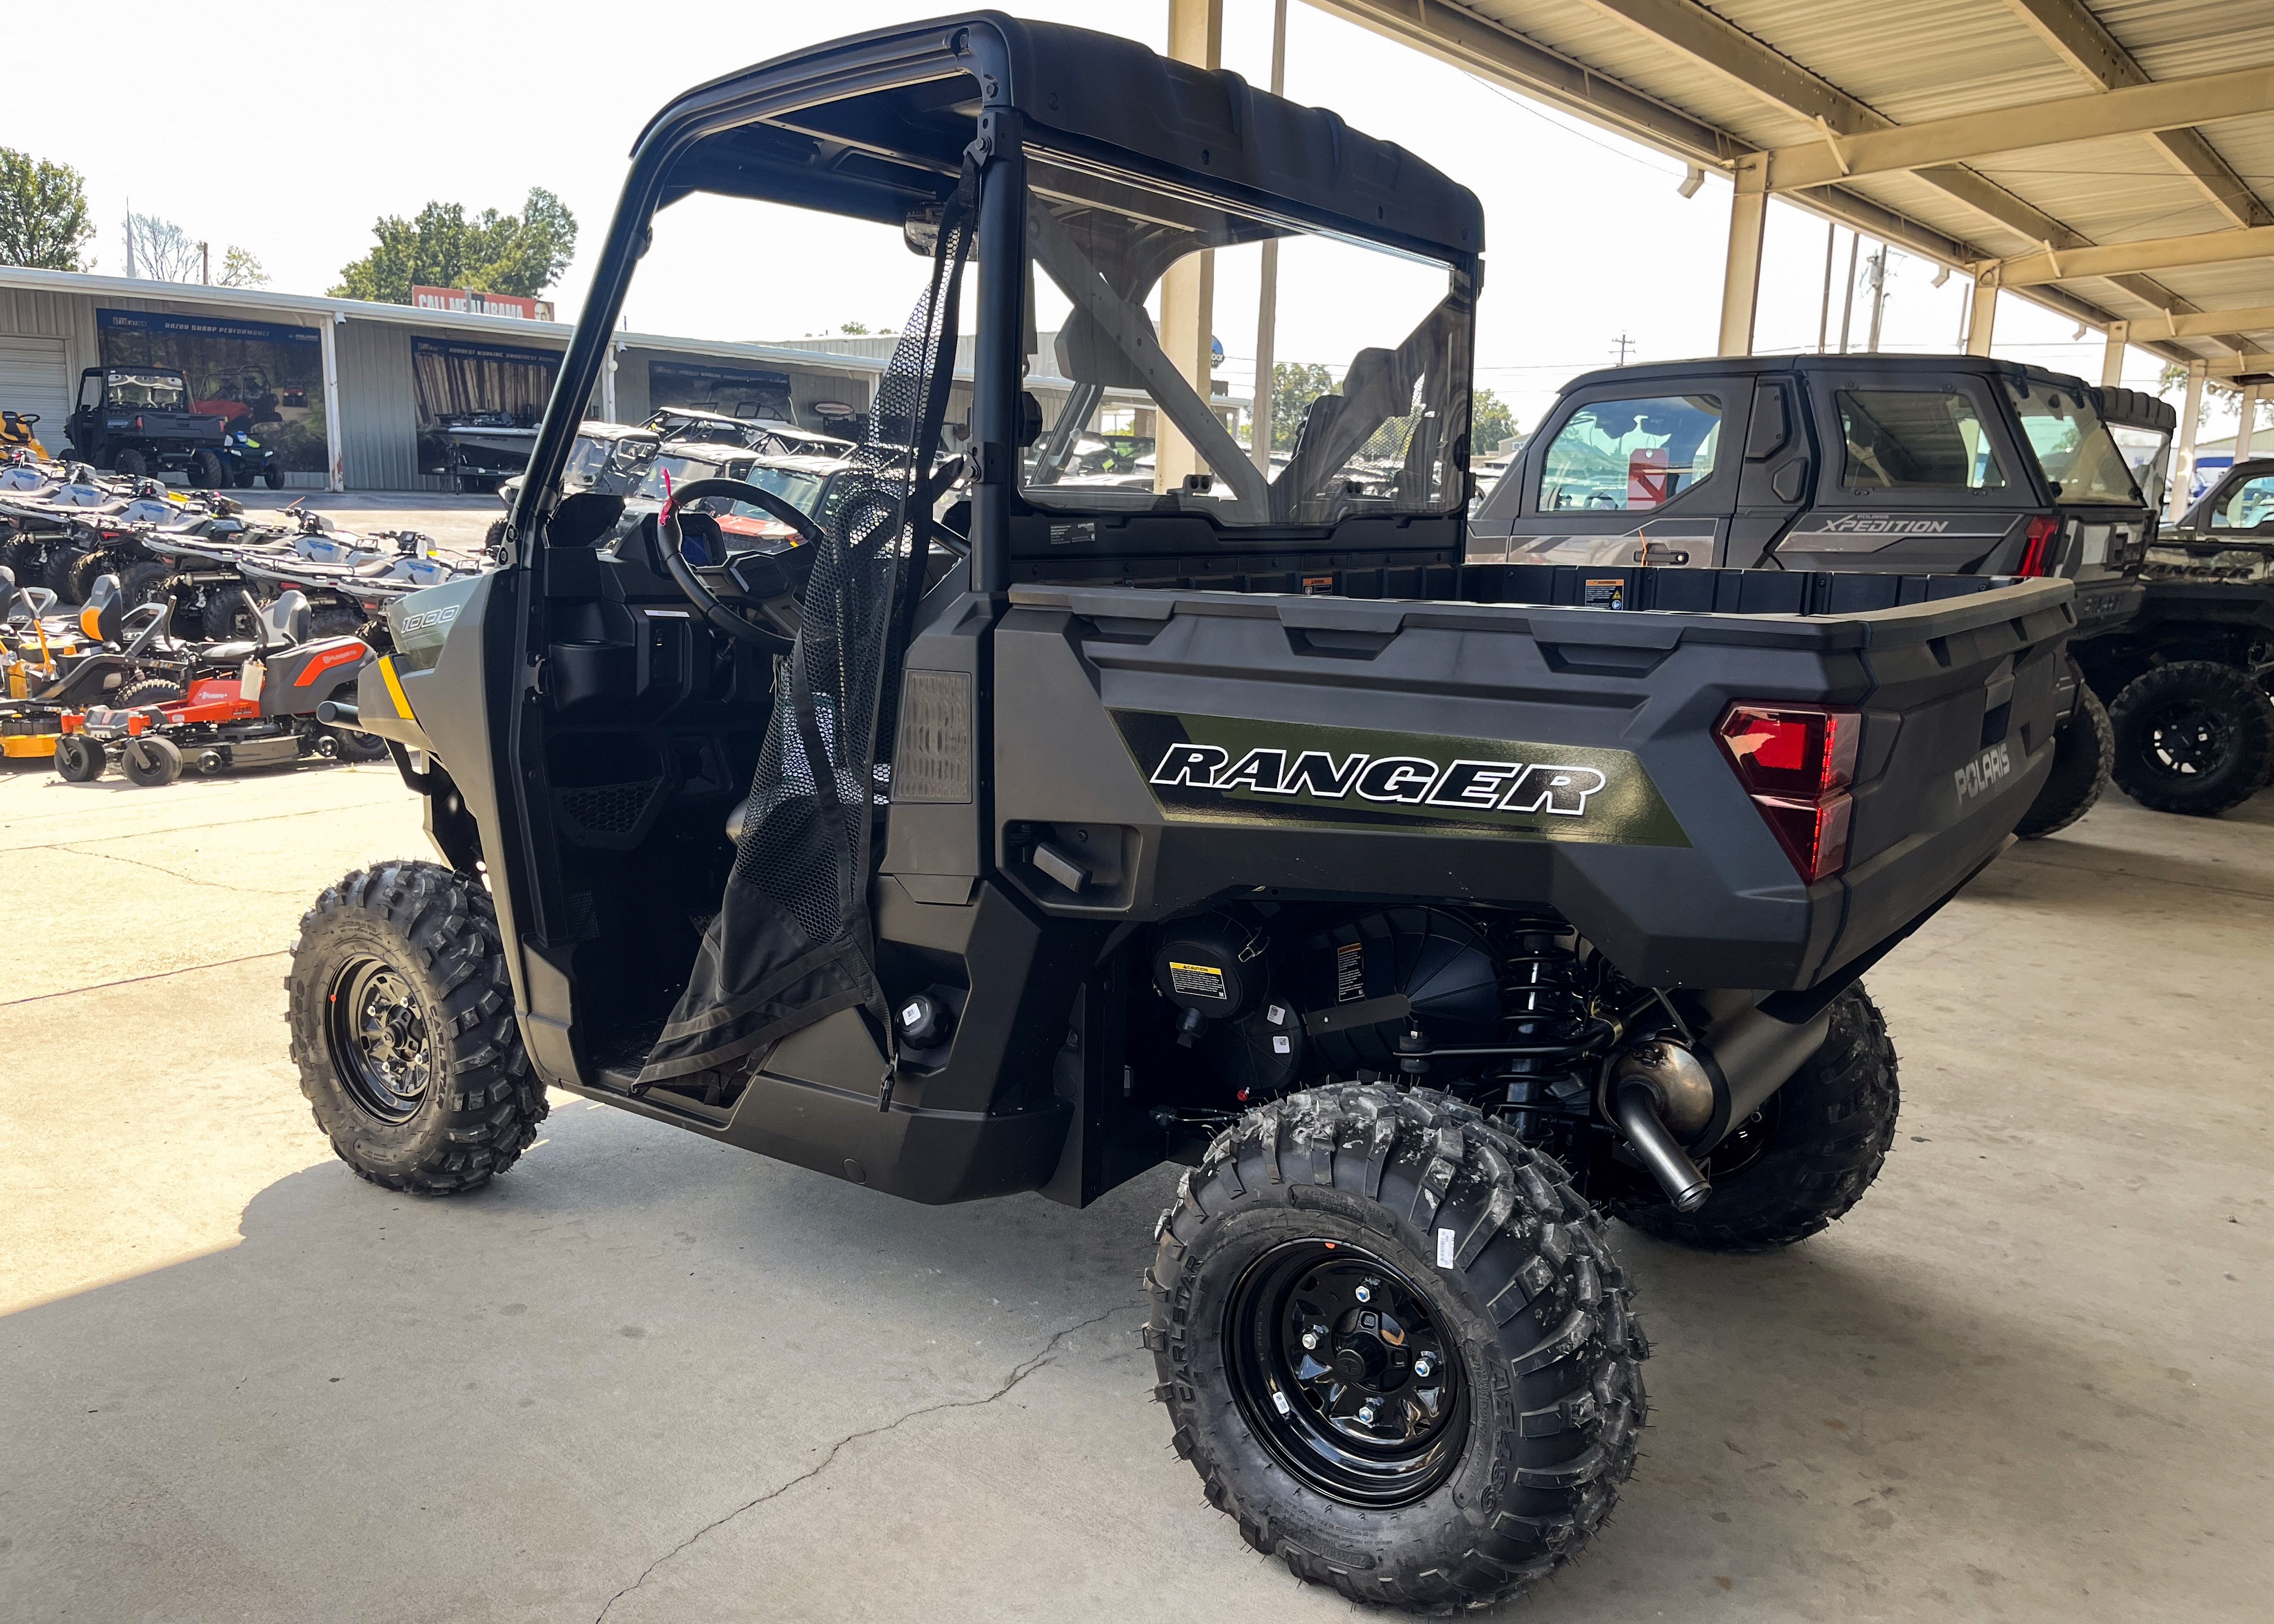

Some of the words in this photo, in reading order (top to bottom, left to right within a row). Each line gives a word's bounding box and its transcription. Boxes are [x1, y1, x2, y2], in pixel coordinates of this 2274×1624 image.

[418, 294, 445, 310] CALL
[218, 327, 271, 337] PERFORMANCE
[1815, 514, 1950, 533] XPEDITION
[401, 604, 460, 634] 1000
[1149, 742, 1607, 817] RANGER
[1954, 742, 2010, 806] POLARIS
[430, 1005, 447, 1110] CARLSTAR
[1171, 1254, 1204, 1404] CARLSTAR
